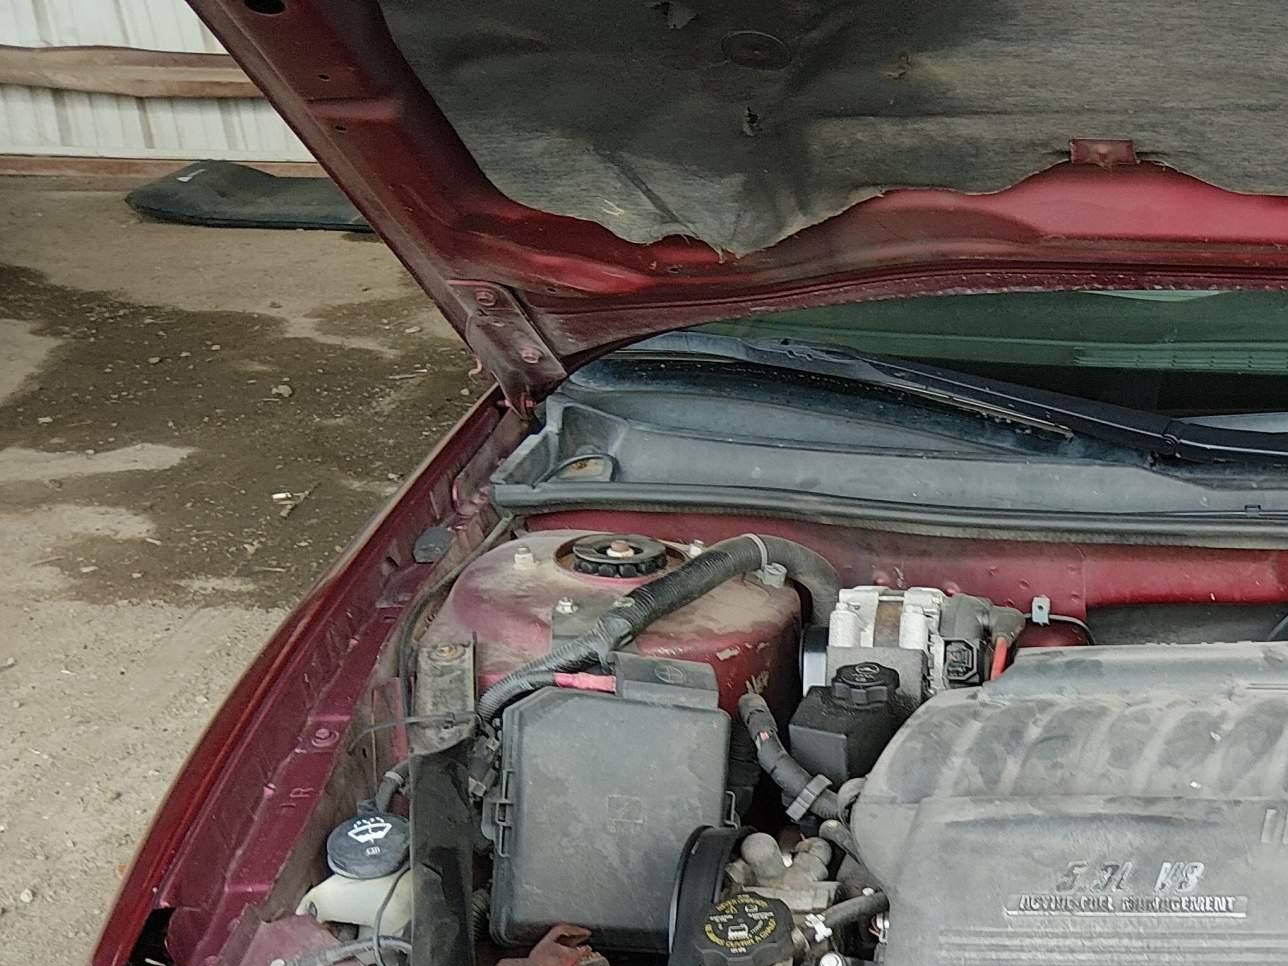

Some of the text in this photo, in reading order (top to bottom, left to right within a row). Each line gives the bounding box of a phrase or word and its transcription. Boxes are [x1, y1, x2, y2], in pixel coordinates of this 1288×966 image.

[1019, 895, 1237, 913] ACTIVE FUEL MANAGEMENT
